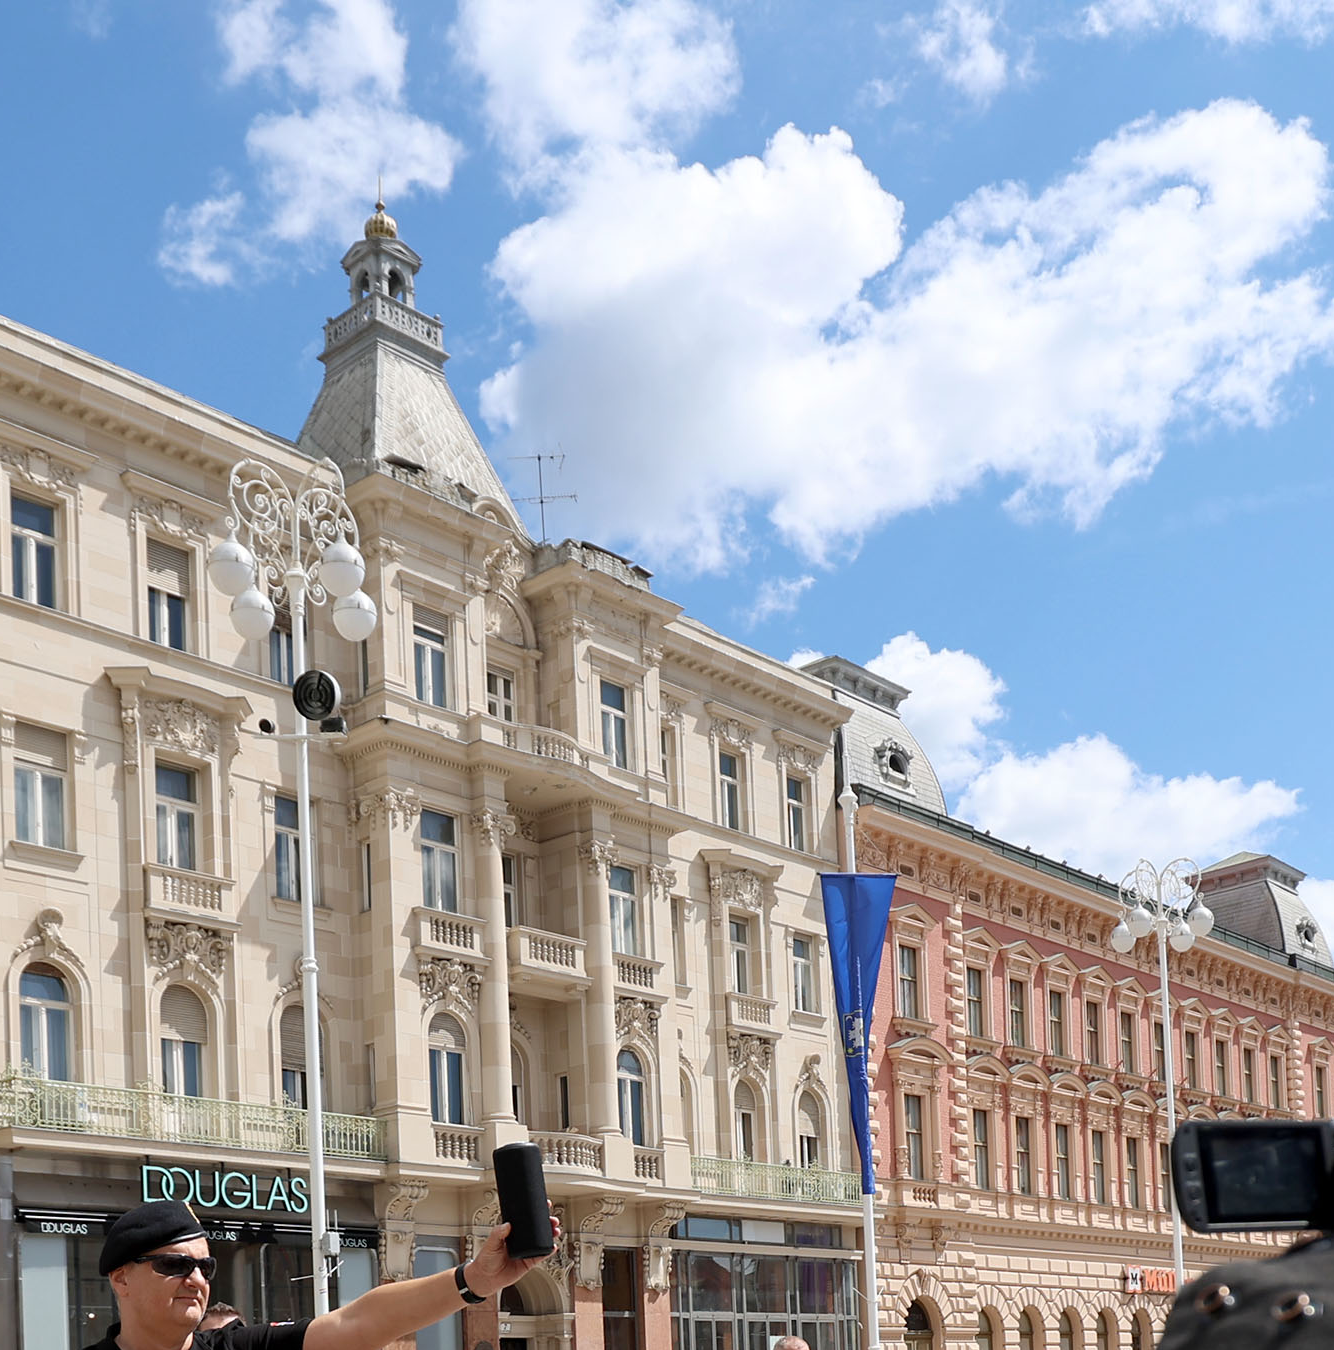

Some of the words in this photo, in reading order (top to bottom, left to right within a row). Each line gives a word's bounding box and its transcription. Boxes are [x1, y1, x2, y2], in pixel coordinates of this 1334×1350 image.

[142, 1165, 309, 1214] DOUGLAS
[40, 1221, 88, 1236] DOUGLAS
[206, 1230, 237, 1242] UGLAS
